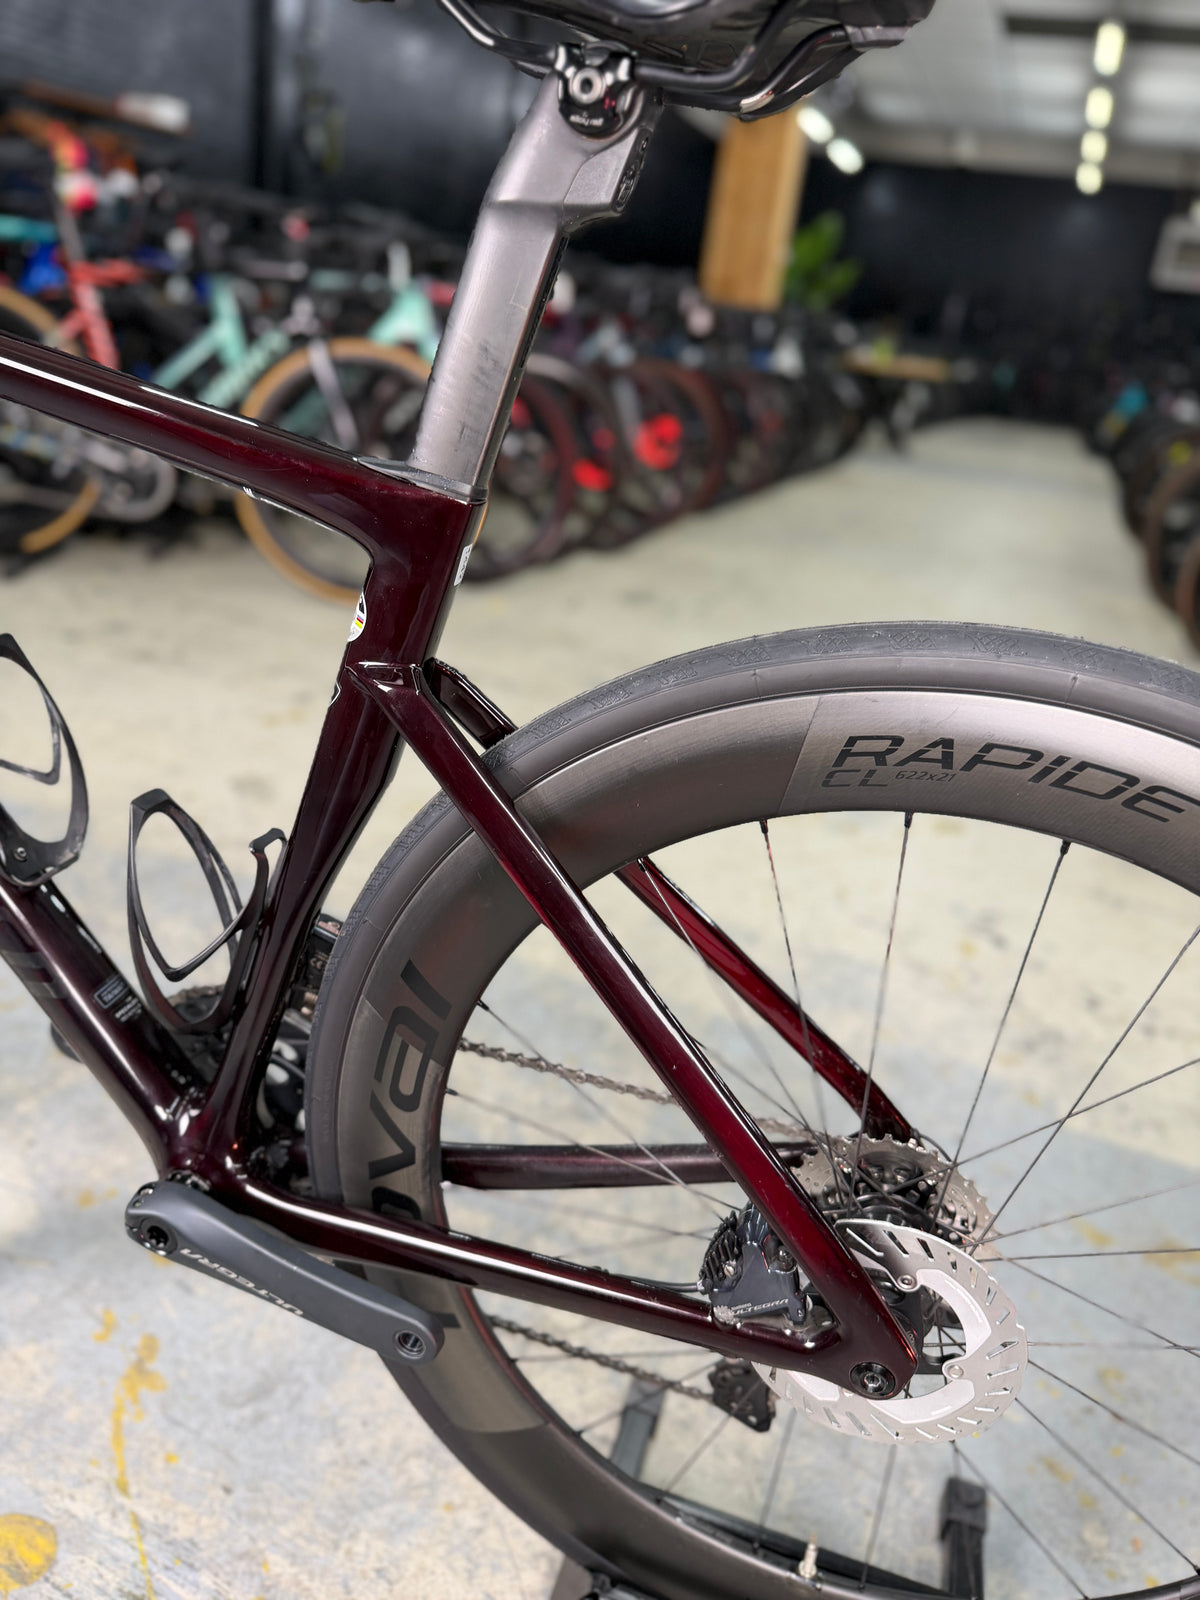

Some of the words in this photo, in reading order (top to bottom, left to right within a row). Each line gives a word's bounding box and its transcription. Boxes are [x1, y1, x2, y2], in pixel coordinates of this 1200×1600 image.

[821, 769, 888, 787] CL
[895, 770, 957, 782] 622x21
[832, 735, 1200, 822] RAPIDE
[180, 1248, 304, 1316] ULTEGRA
